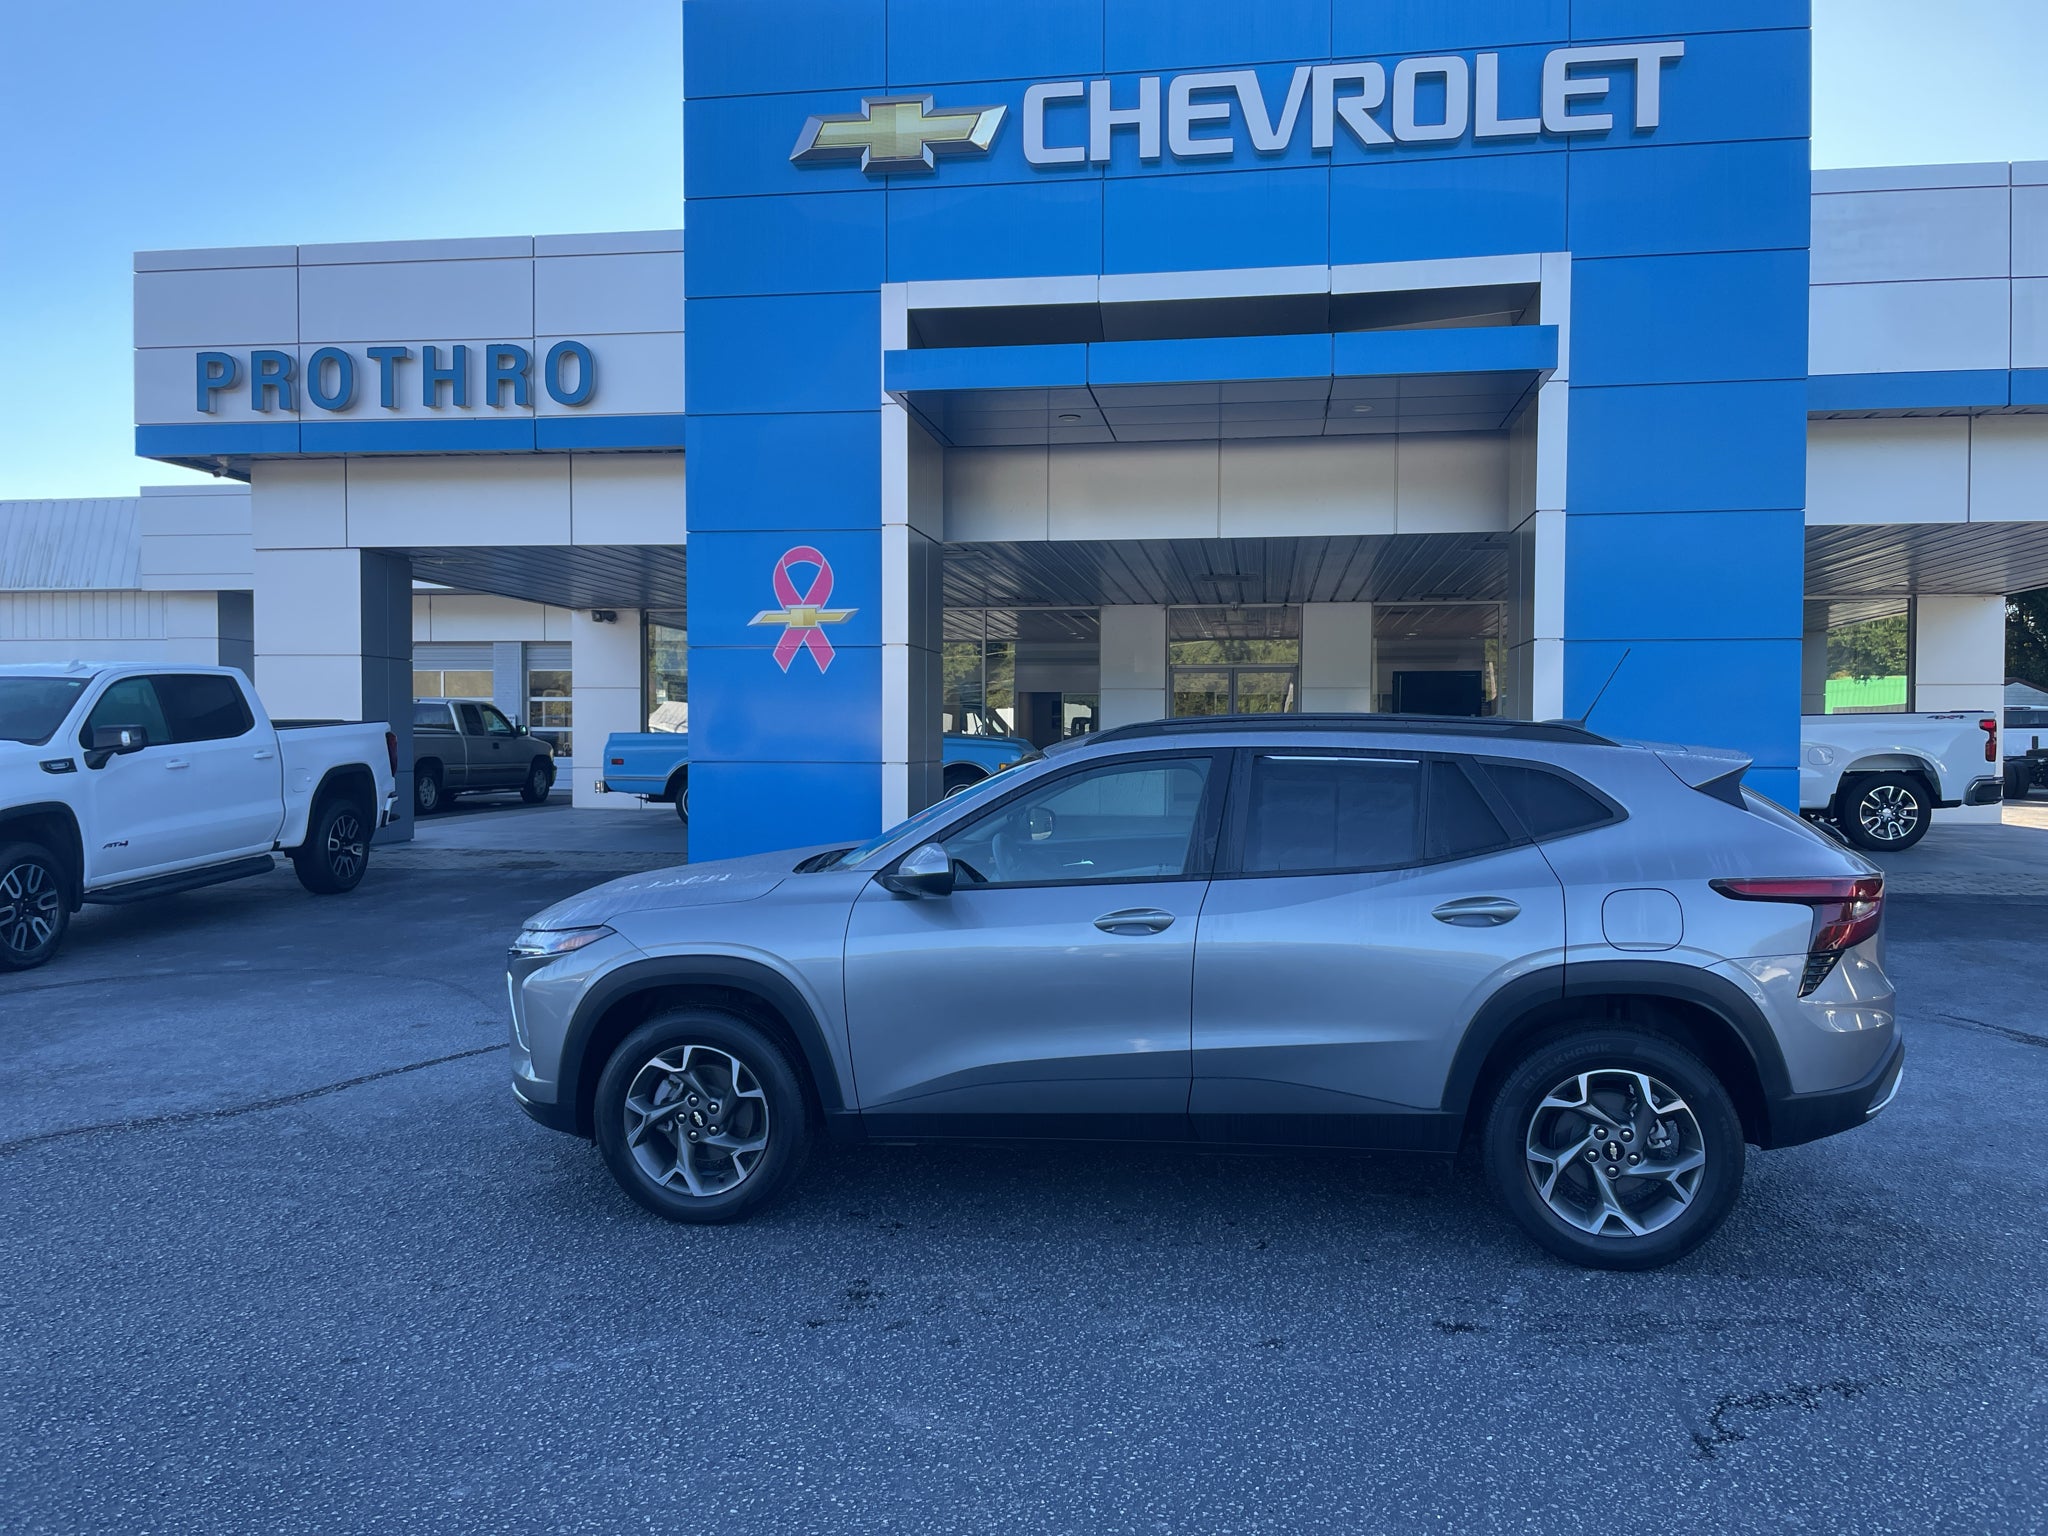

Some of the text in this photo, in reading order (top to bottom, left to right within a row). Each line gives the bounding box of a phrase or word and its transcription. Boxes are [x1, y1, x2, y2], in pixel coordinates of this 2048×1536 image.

[1022, 41, 1685, 168] CHEVROLET
[196, 340, 598, 415] PROTHRO
[103, 840, 129, 849] AT4
[1523, 1042, 1613, 1088] BLACKHAWK
